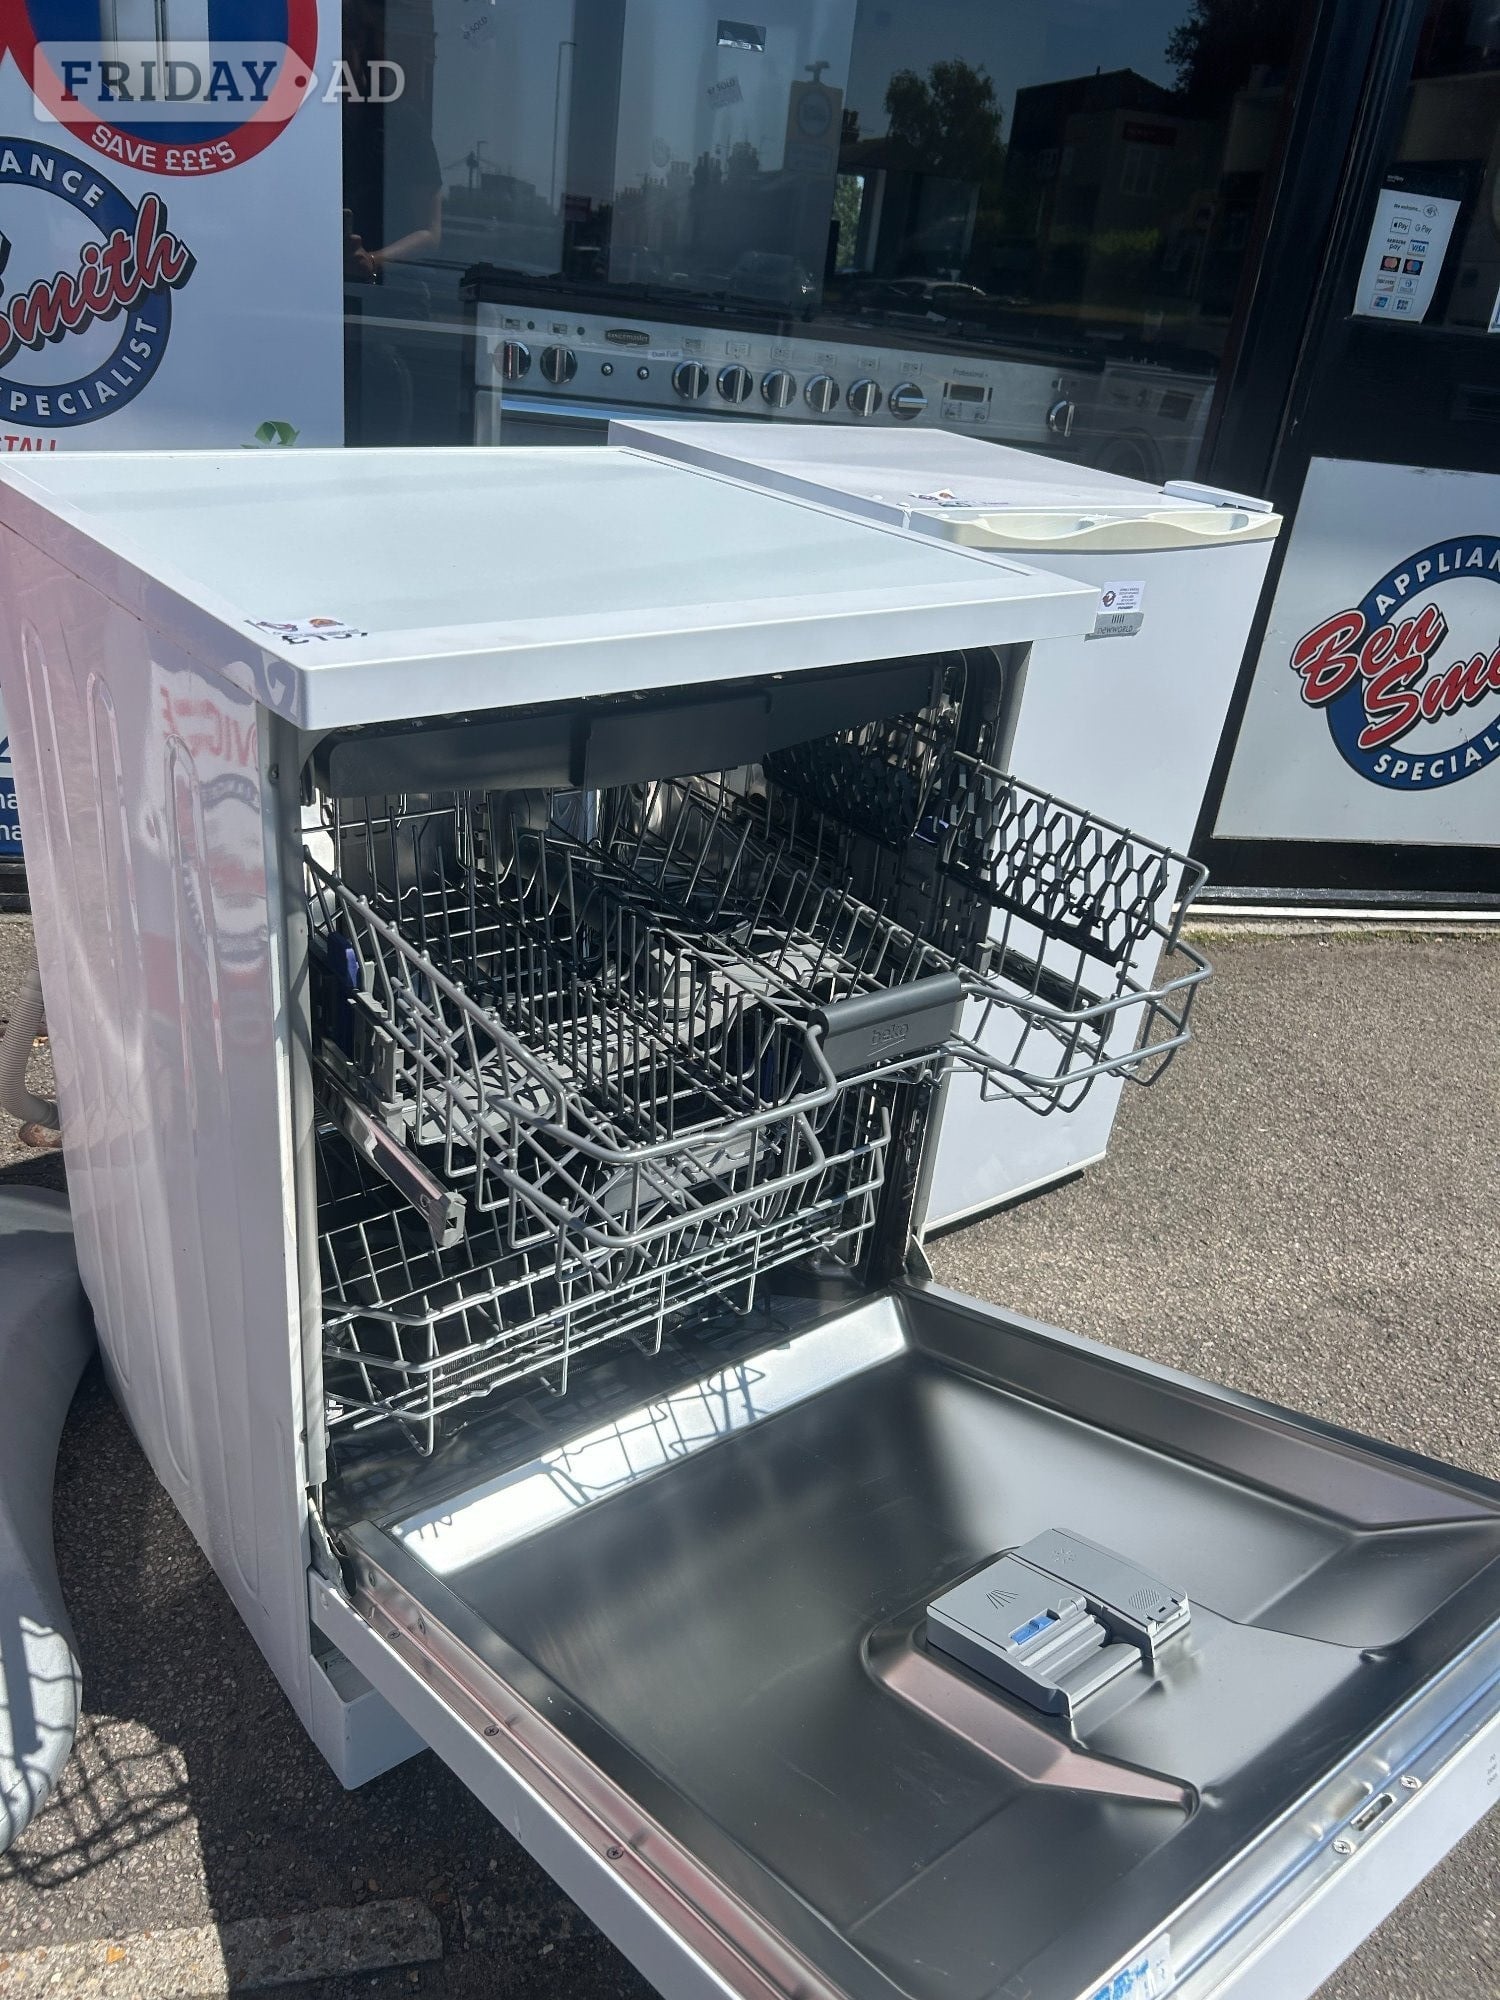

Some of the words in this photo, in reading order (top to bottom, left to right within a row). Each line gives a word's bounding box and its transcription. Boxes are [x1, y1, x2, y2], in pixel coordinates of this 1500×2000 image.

[91, 125, 157, 168] SAVE
[1397, 221, 1408, 231] Pay
[1411, 244, 1426, 253] VISA
[1421, 224, 1433, 235] Pay
[0, 191, 198, 368] mith
[0, 316, 158, 416] PECIALIST
[1290, 602, 1449, 709] Ben
[1373, 723, 1500, 782] SPECIAL
